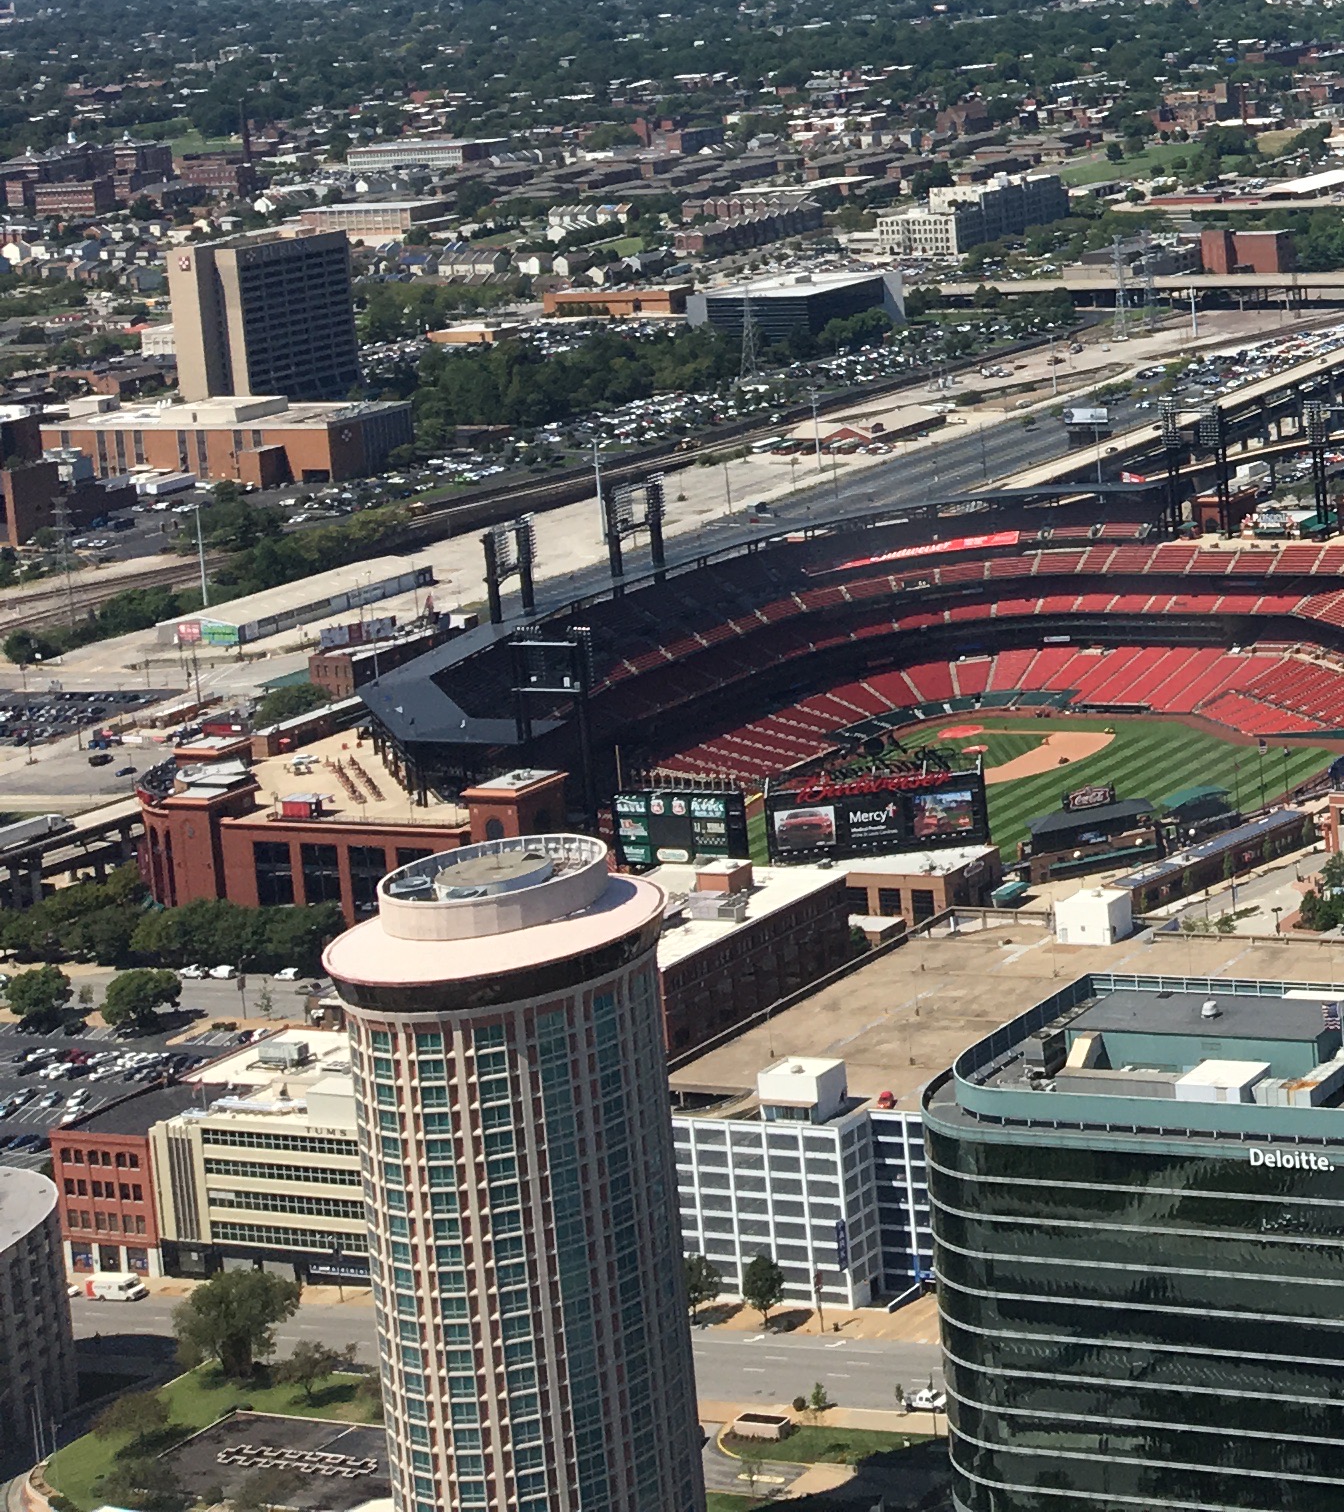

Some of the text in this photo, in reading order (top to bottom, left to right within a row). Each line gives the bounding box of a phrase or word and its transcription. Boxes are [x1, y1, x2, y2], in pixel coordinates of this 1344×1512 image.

[849, 810, 888, 824] Mercy
[304, 1126, 347, 1137] TUMS
[1249, 1147, 1335, 1172] Deloitte.
